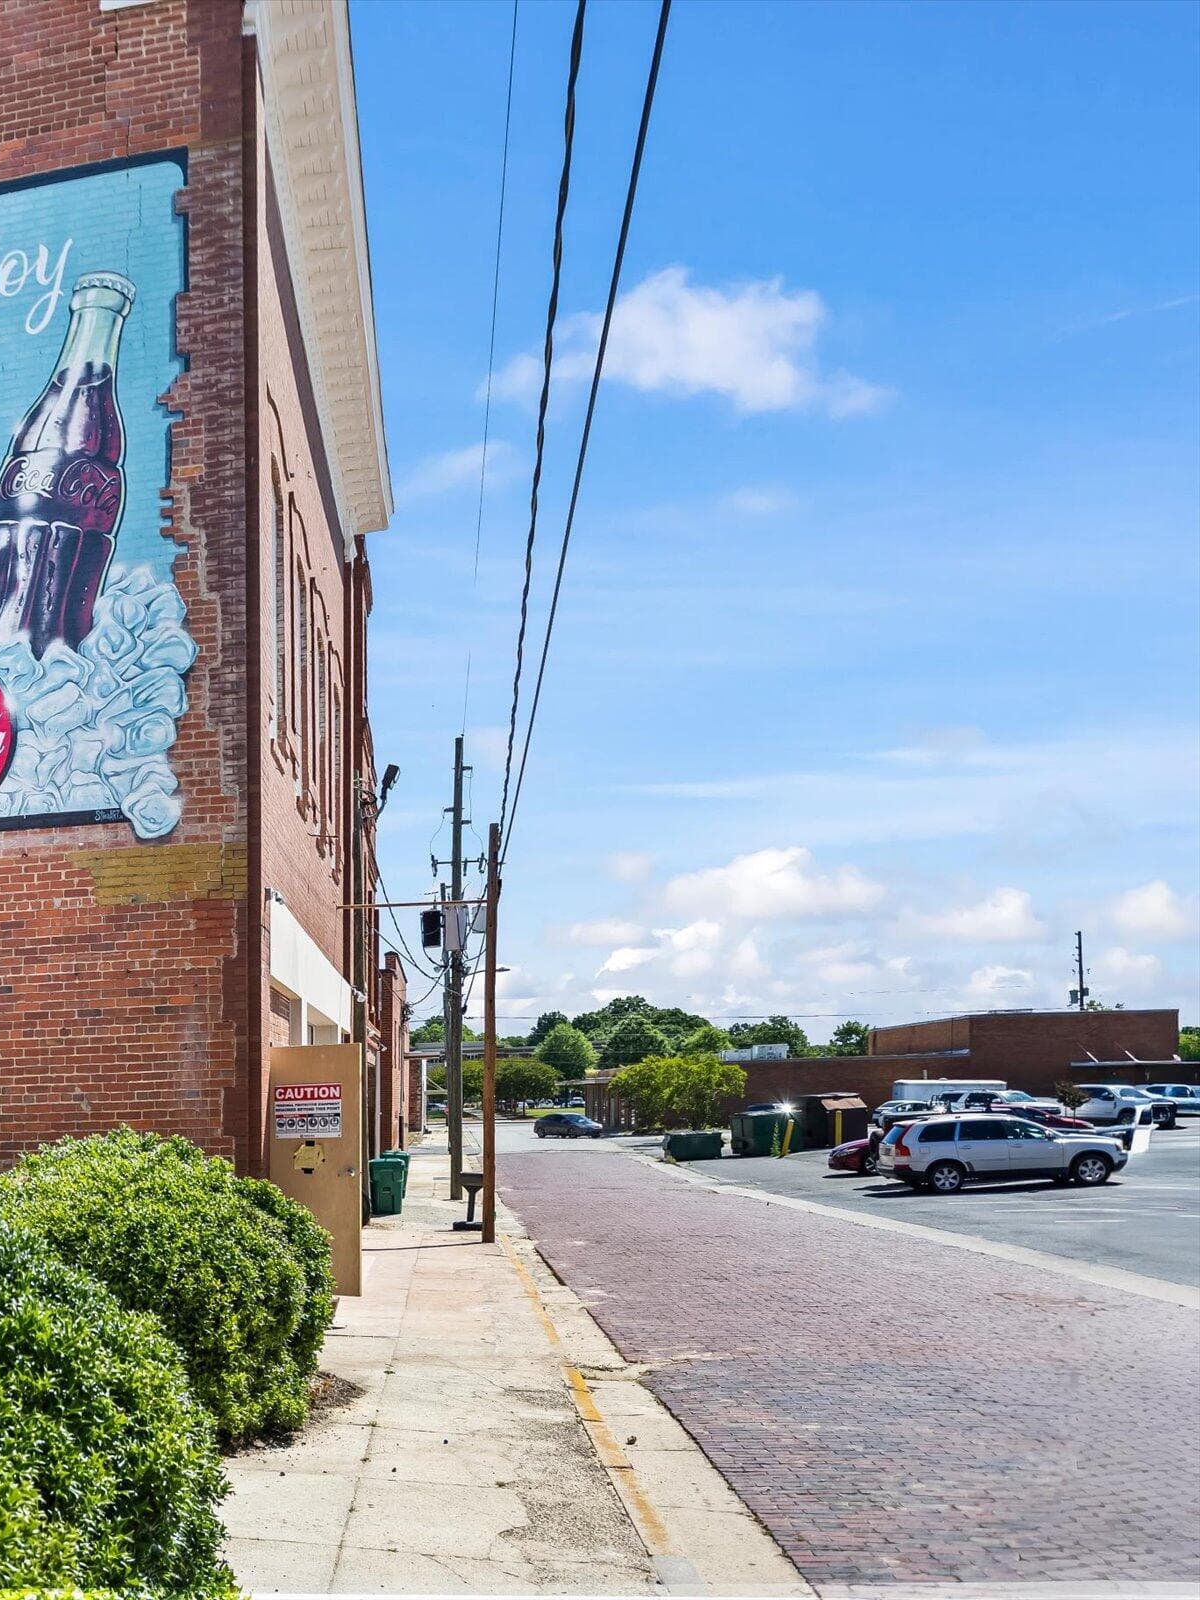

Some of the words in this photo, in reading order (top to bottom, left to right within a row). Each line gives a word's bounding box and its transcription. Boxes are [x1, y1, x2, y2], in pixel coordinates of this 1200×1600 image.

[0, 456, 54, 500] Coca
[57, 458, 119, 516] Cola
[275, 1086, 340, 1100] CAUTION
